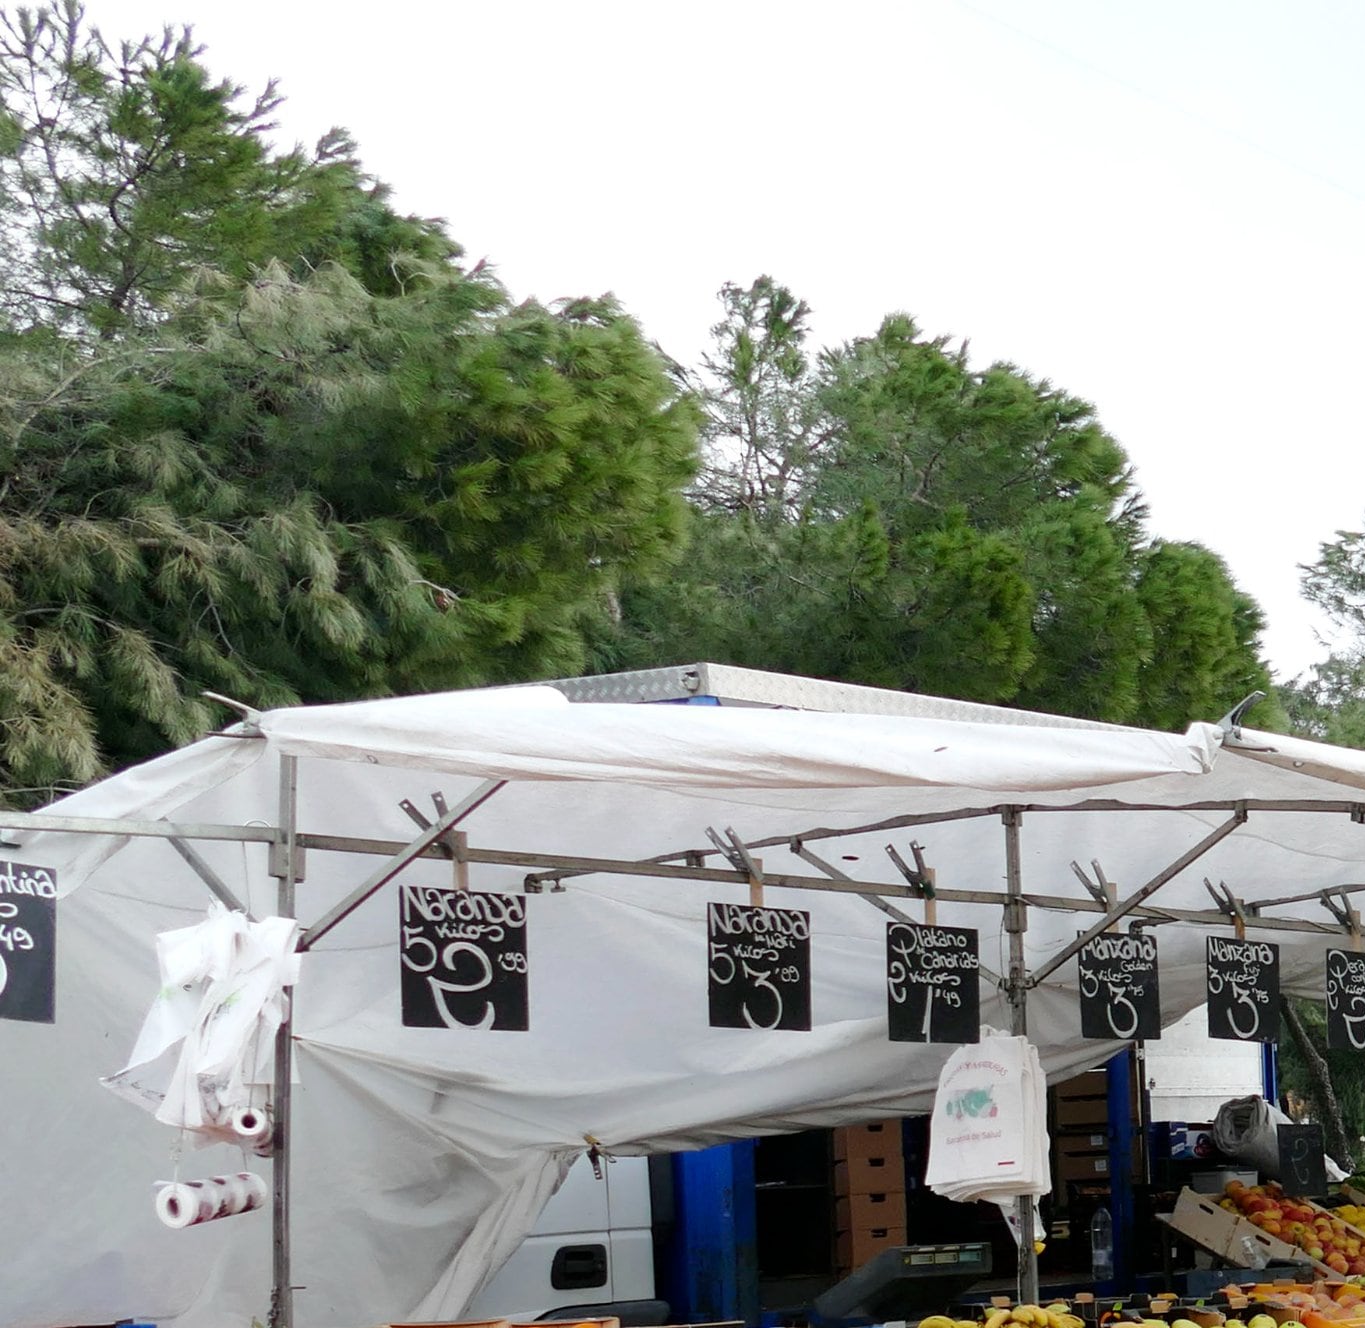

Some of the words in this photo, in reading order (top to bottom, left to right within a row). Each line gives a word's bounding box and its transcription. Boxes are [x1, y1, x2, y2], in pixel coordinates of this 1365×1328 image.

[402, 885, 527, 928] Naranja
[709, 903, 810, 940] Naranja
[402, 925, 437, 972] 5
[710, 941, 735, 985] 5
[1080, 934, 1156, 961] Manzana
[1208, 936, 1274, 965] Manzana
[888, 961, 906, 1003] 2
[1080, 965, 1098, 998] 3
[1208, 965, 1223, 994] 3
[1327, 980, 1338, 1010] 2
